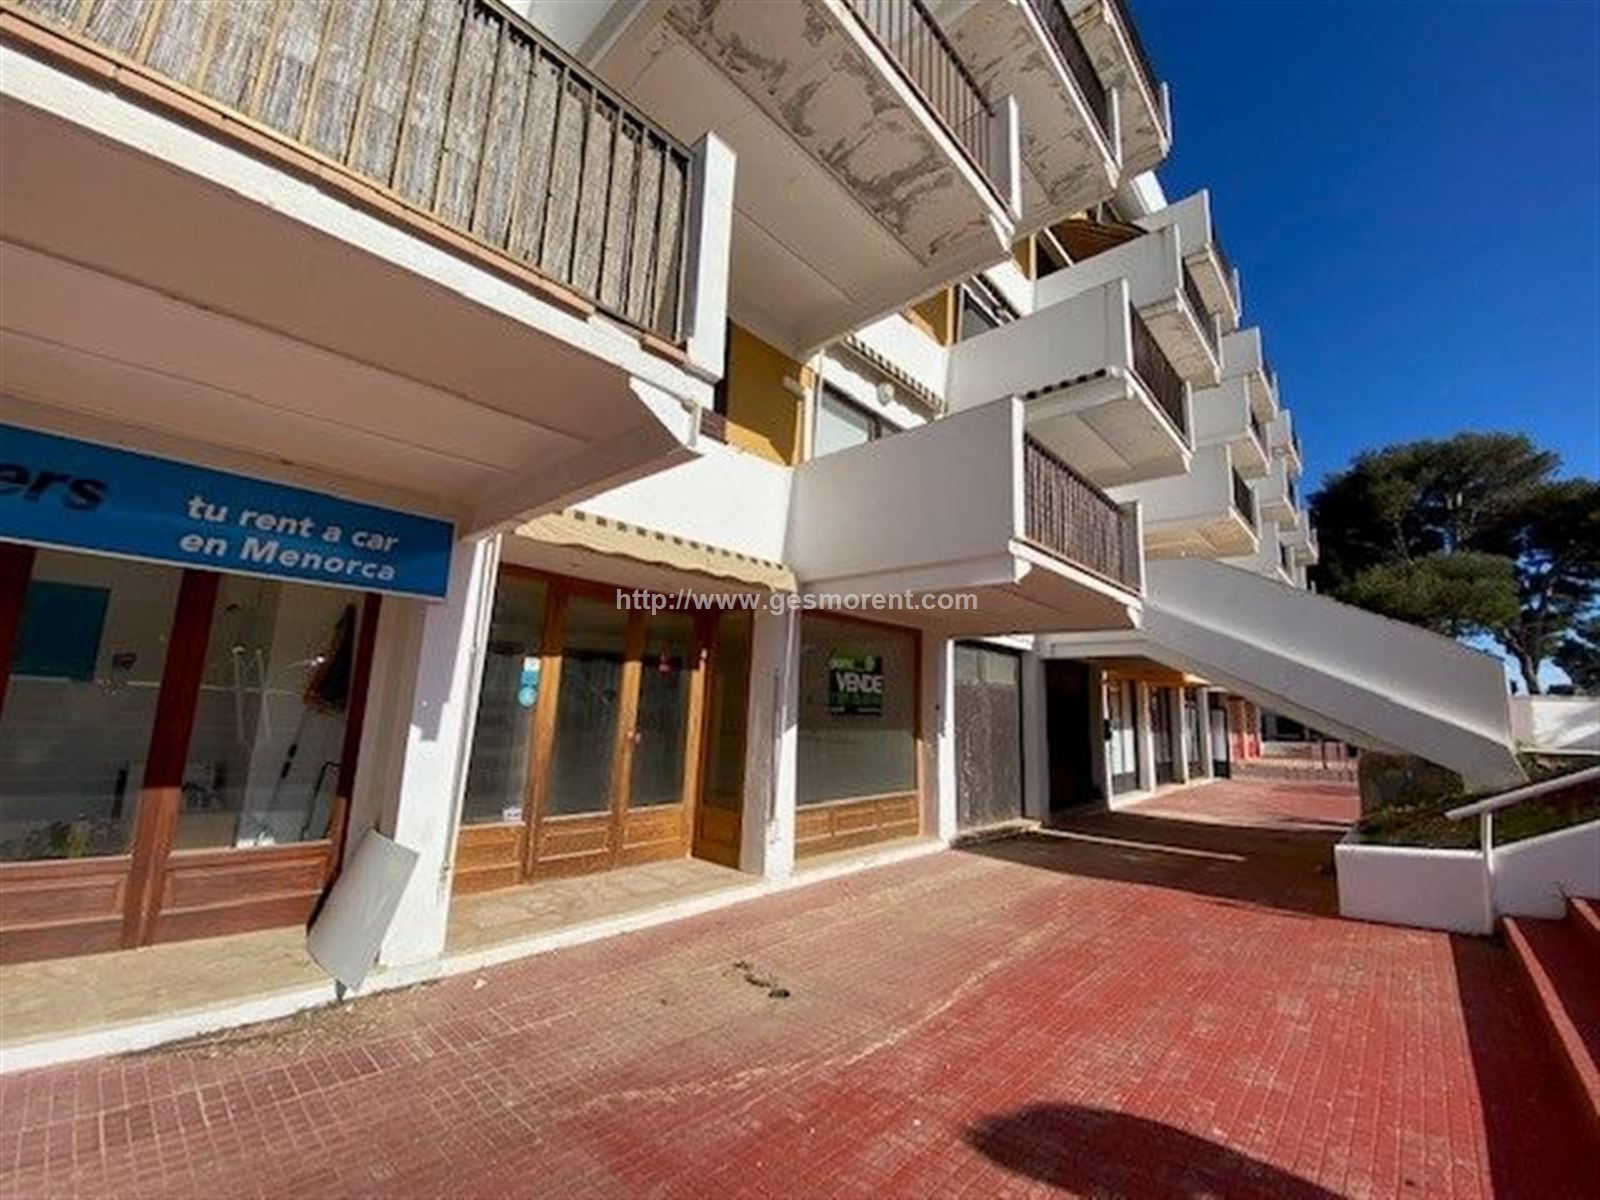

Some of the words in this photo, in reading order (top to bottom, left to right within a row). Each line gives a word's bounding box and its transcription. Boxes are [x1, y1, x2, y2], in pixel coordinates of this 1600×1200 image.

[187, 495, 228, 522] tu
[239, 506, 315, 538] rent
[322, 525, 341, 542] a
[351, 532, 399, 553] car
[180, 532, 227, 557] en
[239, 537, 397, 581] Menorca
[835, 672, 883, 694] VENDE
